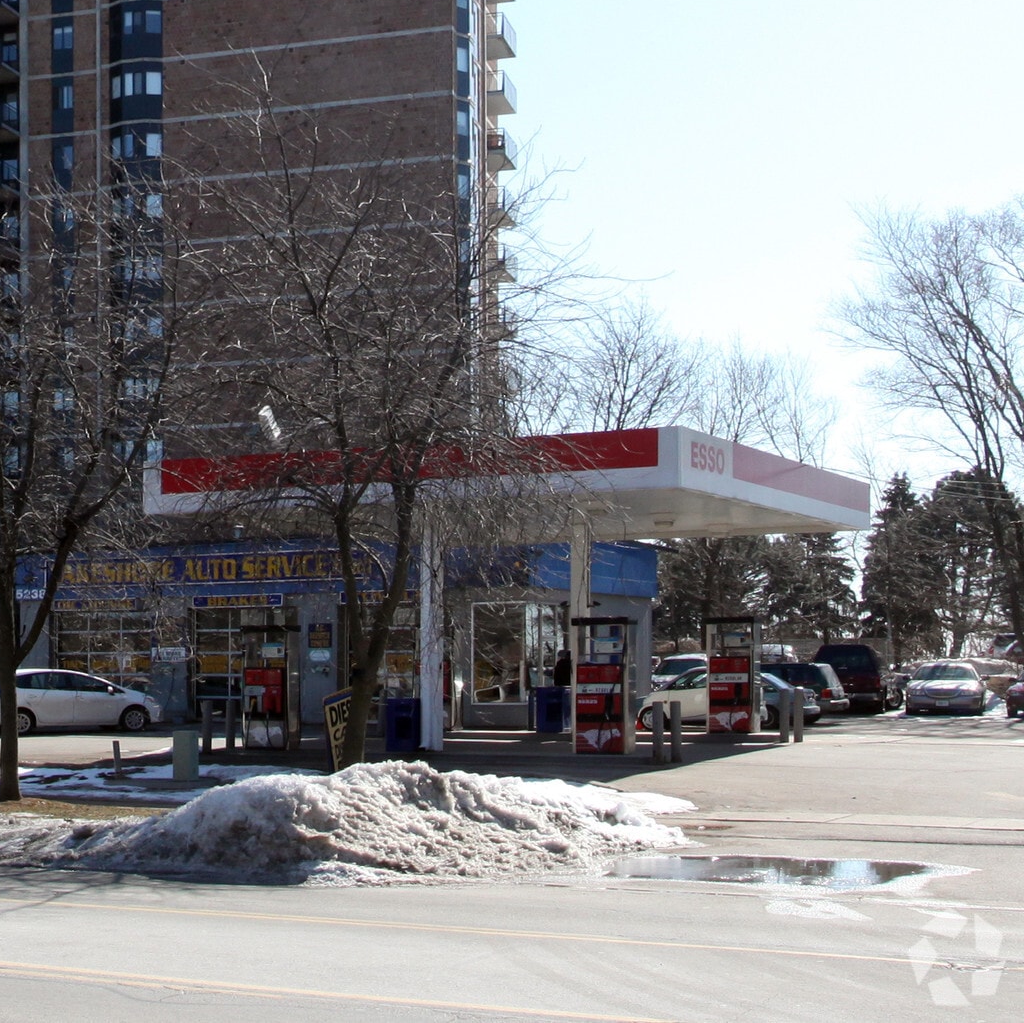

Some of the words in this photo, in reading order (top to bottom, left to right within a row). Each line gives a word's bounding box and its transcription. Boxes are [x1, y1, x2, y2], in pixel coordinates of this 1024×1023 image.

[690, 441, 725, 475] ESSO
[59, 560, 174, 584] AKESHORE
[183, 558, 238, 580] AUTO
[241, 552, 327, 578] SERVICE
